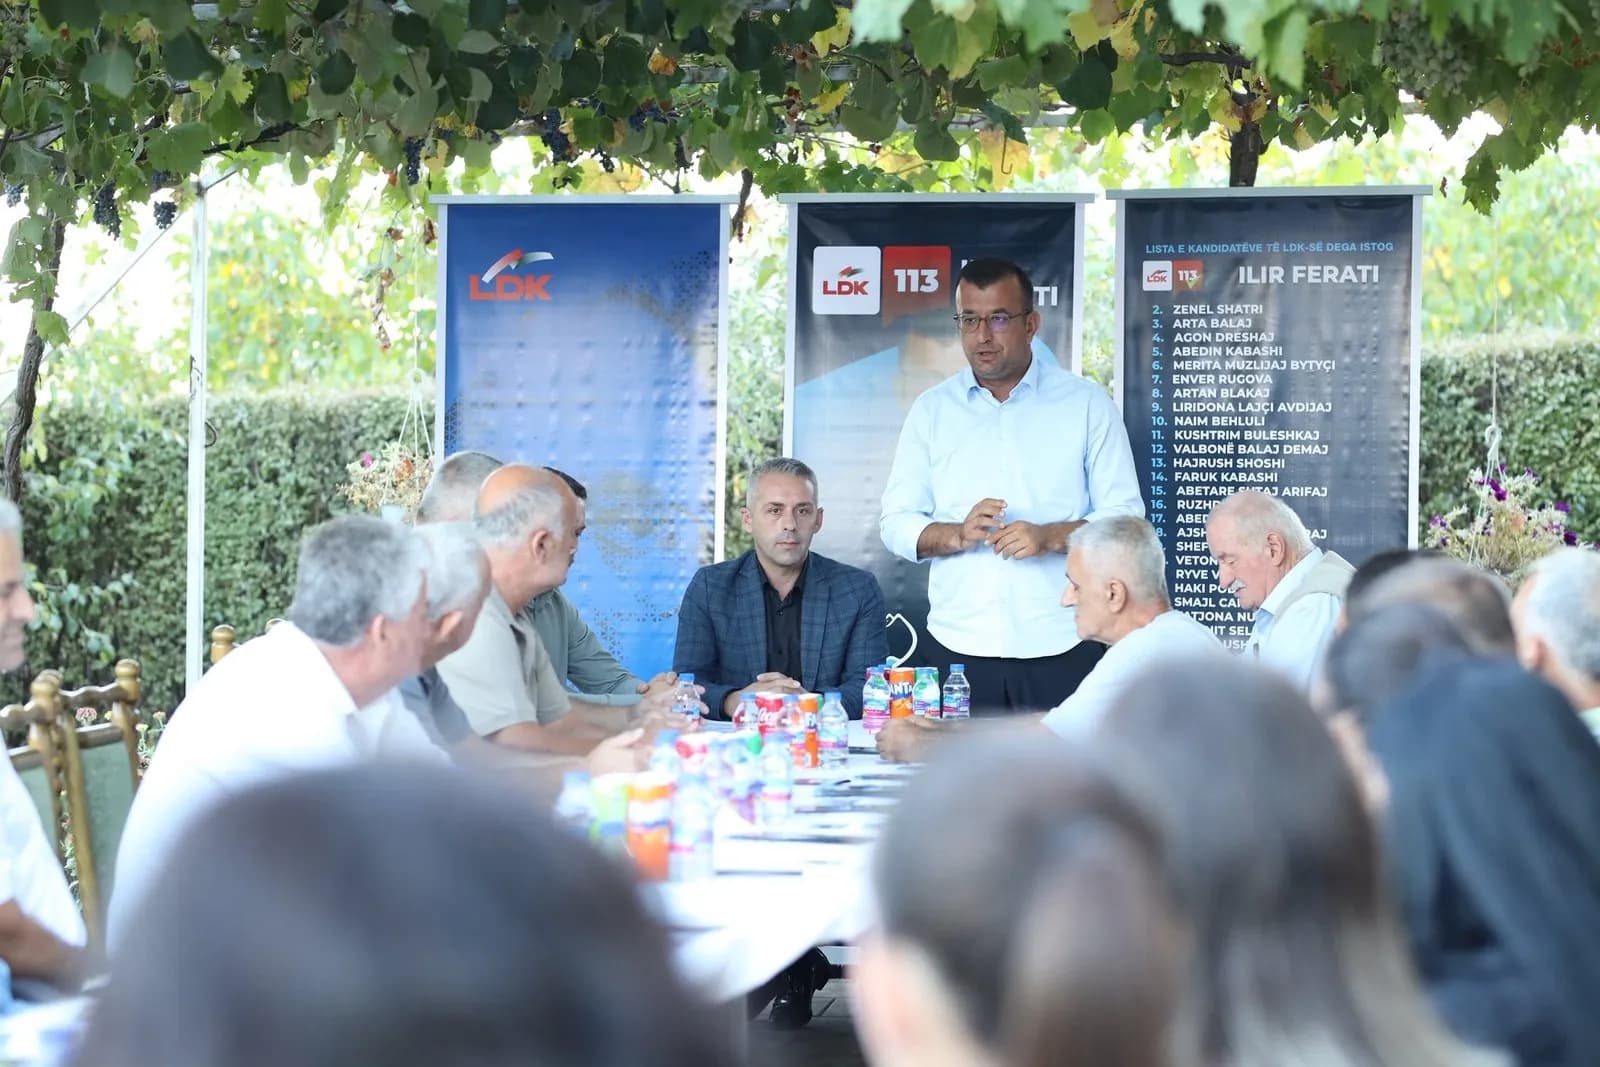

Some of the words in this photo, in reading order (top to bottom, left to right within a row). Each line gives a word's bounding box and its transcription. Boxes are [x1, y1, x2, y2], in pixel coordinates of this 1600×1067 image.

[1146, 244, 1174, 254] LISTA
[1178, 244, 1185, 253] E
[1188, 242, 1263, 253] KANDIDATËVE
[1267, 241, 1280, 253] TË
[1326, 242, 1356, 252] DEGA
[1360, 241, 1394, 252] ISTOG
[1147, 272, 1168, 283] LDK
[1178, 270, 1198, 280] 113
[1239, 266, 1283, 284] ILIR
[1292, 265, 1379, 284] FERATI
[894, 269, 939, 293] 113
[469, 274, 553, 301] LDK
[823, 280, 869, 295] LDK
[1152, 306, 1162, 314] 2.
[1173, 305, 1214, 314] ZENEL
[1217, 305, 1263, 314] SHATRI
[1152, 320, 1163, 328] 3.
[1173, 319, 1206, 328] ARTA
[1210, 319, 1252, 328] BALAJ
[1152, 334, 1164, 342] 4.
[1174, 333, 1211, 342] AGON
[1215, 333, 1274, 342] DRESHAJ
[1152, 347, 1162, 356] 5.
[1173, 347, 1222, 356] ABEDIN
[1226, 346, 1282, 356] KABASHI
[1152, 361, 1163, 370] 6.
[1174, 360, 1221, 370] MERITA
[1225, 360, 1286, 370] MUZLIJAJ
[1290, 360, 1336, 372] BYTYÇI
[1152, 375, 1162, 384] 7.
[1172, 375, 1215, 384] ENVER
[1219, 375, 1272, 384] RUGOVA
[1152, 389, 1163, 398] 8.
[1173, 389, 1217, 398] ARTAN
[1220, 388, 1270, 398] BLAKAJ
[1152, 403, 1163, 412] 9.
[1173, 403, 1234, 412] LIRIDONA
[1238, 402, 1274, 415] LAJÇI
[1277, 402, 1332, 412] AVDIJAJ
[1152, 417, 1168, 426] 10.
[1174, 416, 1208, 426] NAIM
[1212, 416, 1265, 426] BEHLULI
[1152, 431, 1164, 440] 11.
[1175, 430, 1241, 440] KUSHTRIM
[1244, 430, 1320, 440] BULESHKAJ
[1152, 445, 1166, 454] 12.
[1174, 442, 1234, 454] VALBONË
[1238, 444, 1279, 454] BALAJ
[1283, 444, 1328, 454] DEMAJ
[1152, 458, 1166, 468] 13.
[1174, 458, 1233, 468] HAJRUSH
[1236, 458, 1285, 468] SHOSHI
[1151, 472, 1167, 481] 14.
[1175, 472, 1217, 482] FARUK
[1221, 472, 1278, 482] KABASHI
[1151, 486, 1166, 495] 15.
[1176, 486, 1234, 496] ABETARE
[1283, 487, 1328, 497] ARIFAJ
[1151, 500, 1167, 509] 16.
[1151, 514, 1166, 523] 17.
[1156, 528, 1166, 537] 8.
[1176, 569, 1208, 580] RYVE
[1175, 583, 1205, 594] HAKI
[1174, 596, 1216, 607] SMAJL
